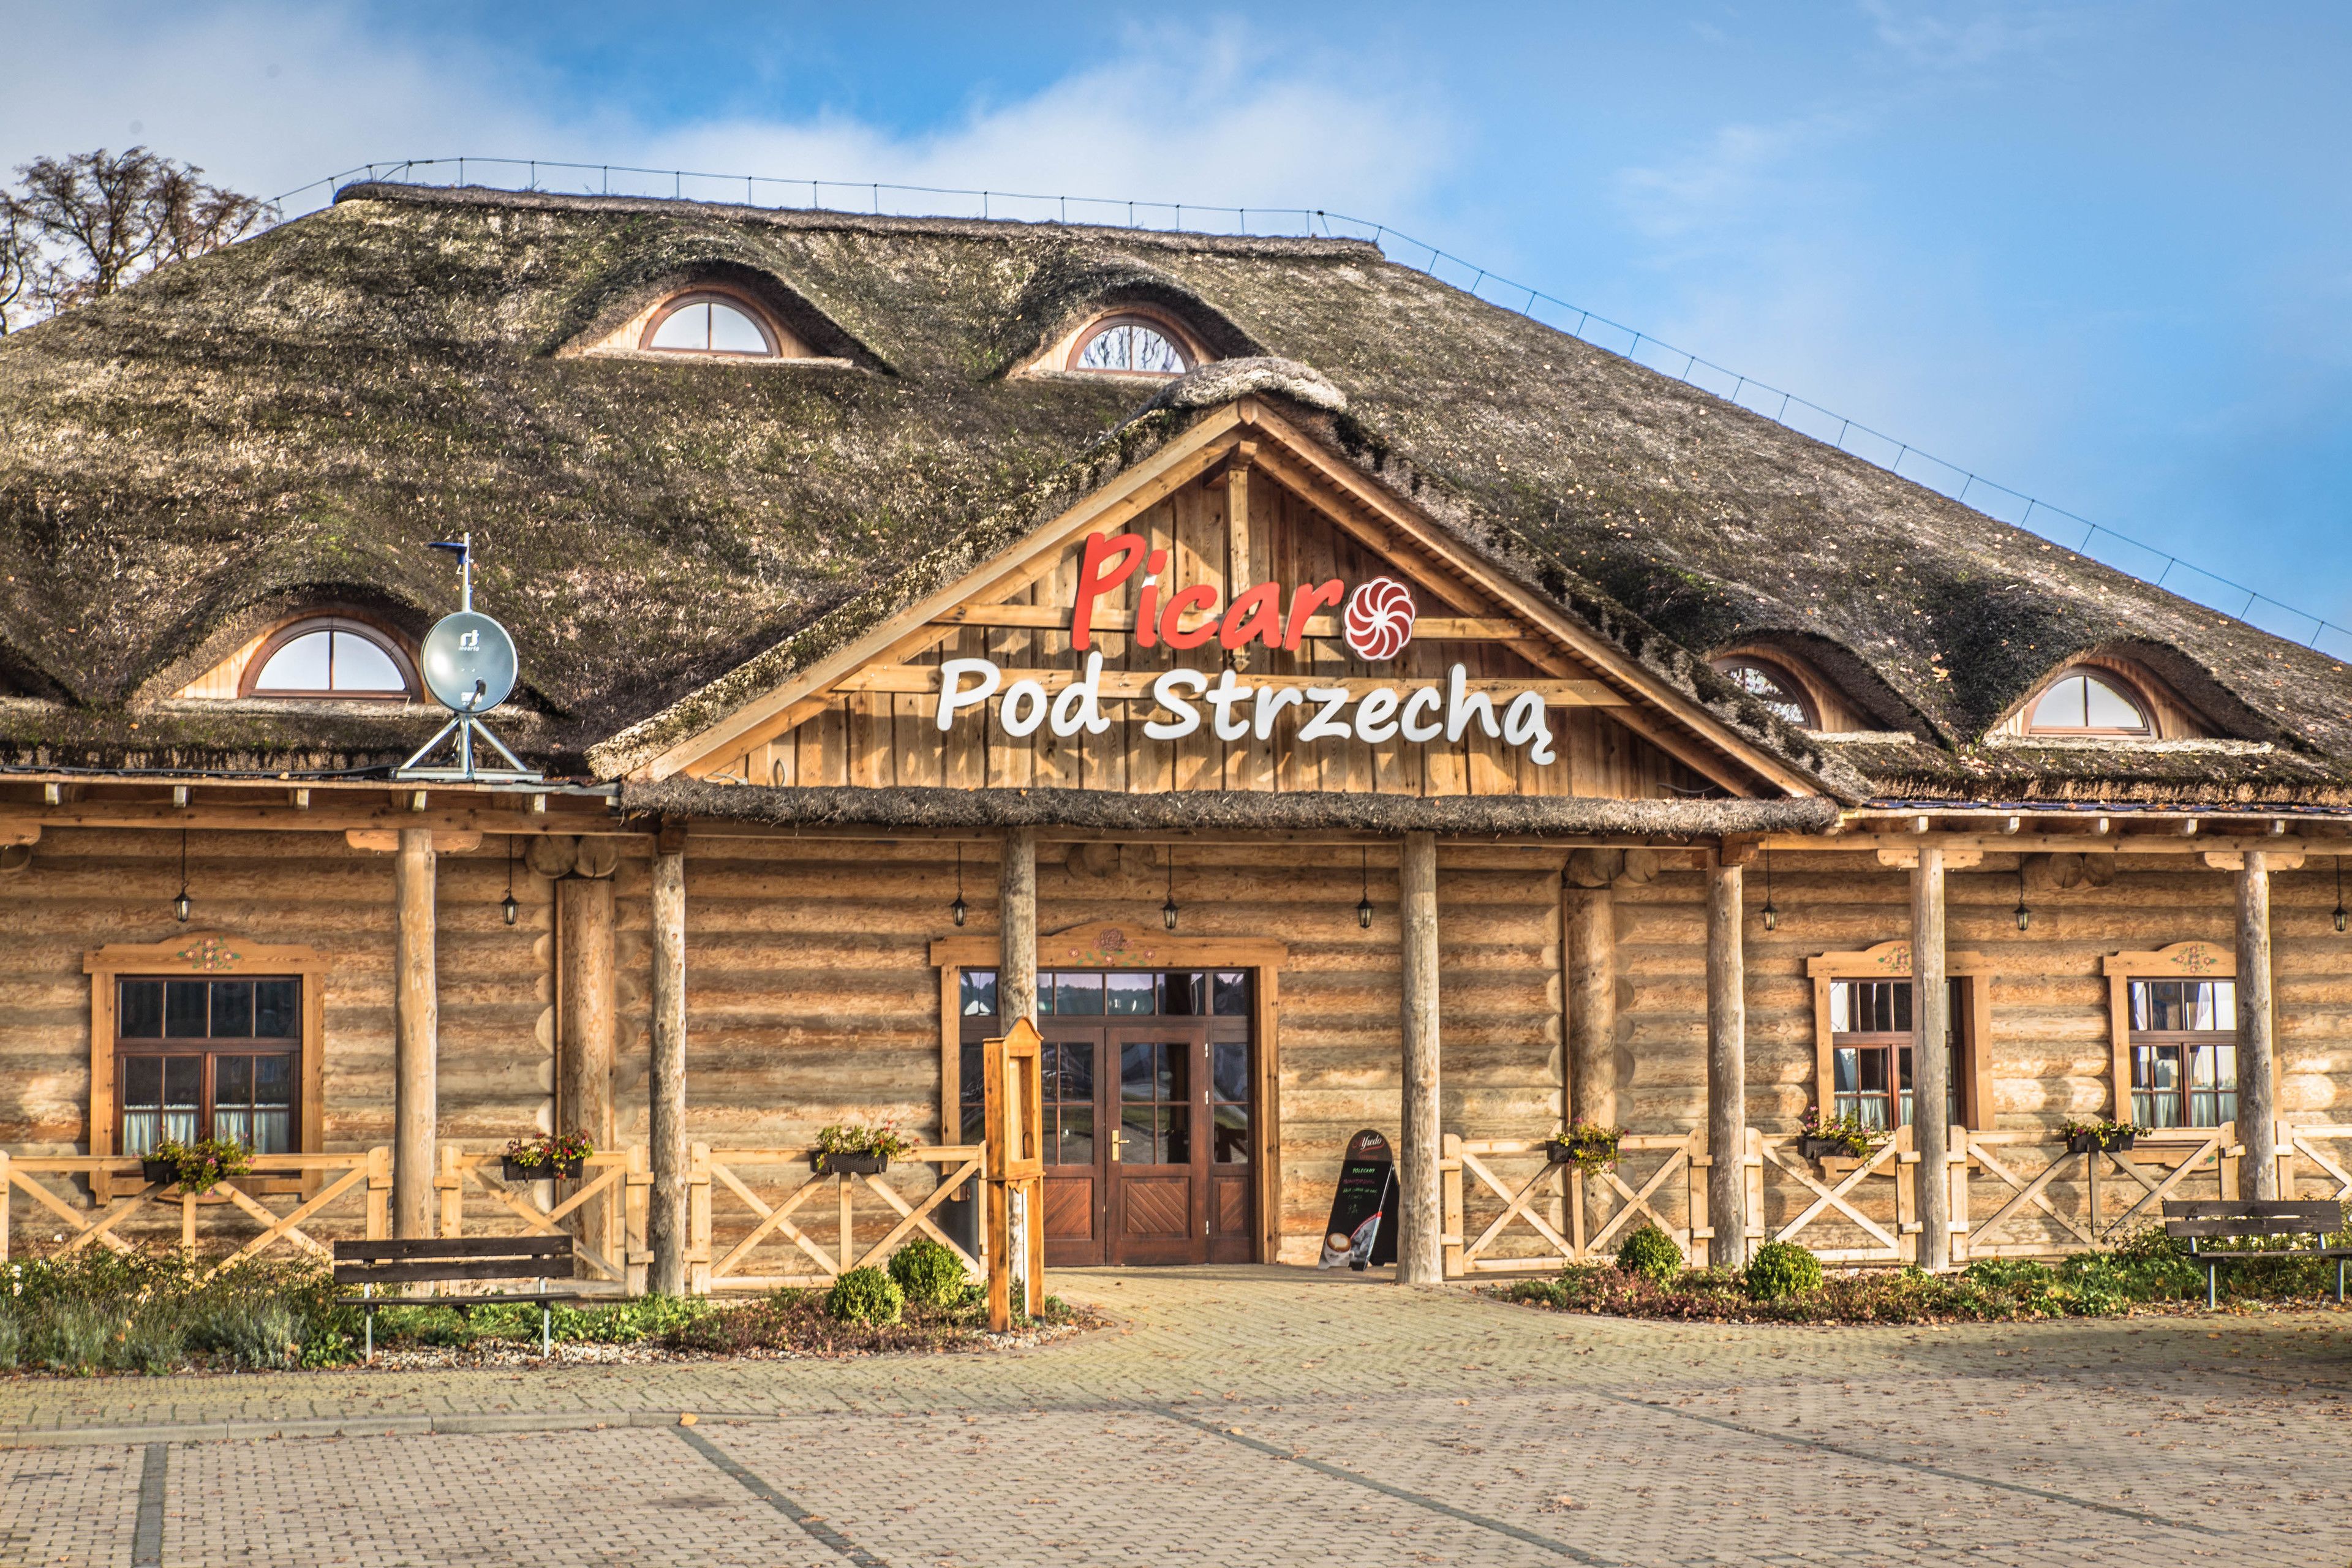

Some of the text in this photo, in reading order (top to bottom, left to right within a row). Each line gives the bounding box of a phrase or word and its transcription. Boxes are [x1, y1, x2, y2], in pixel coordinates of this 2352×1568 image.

[1071, 532, 1344, 650] Picar
[937, 650, 1557, 766] Pod Strzechą
[1352, 1134, 1382, 1150] Alfredo
